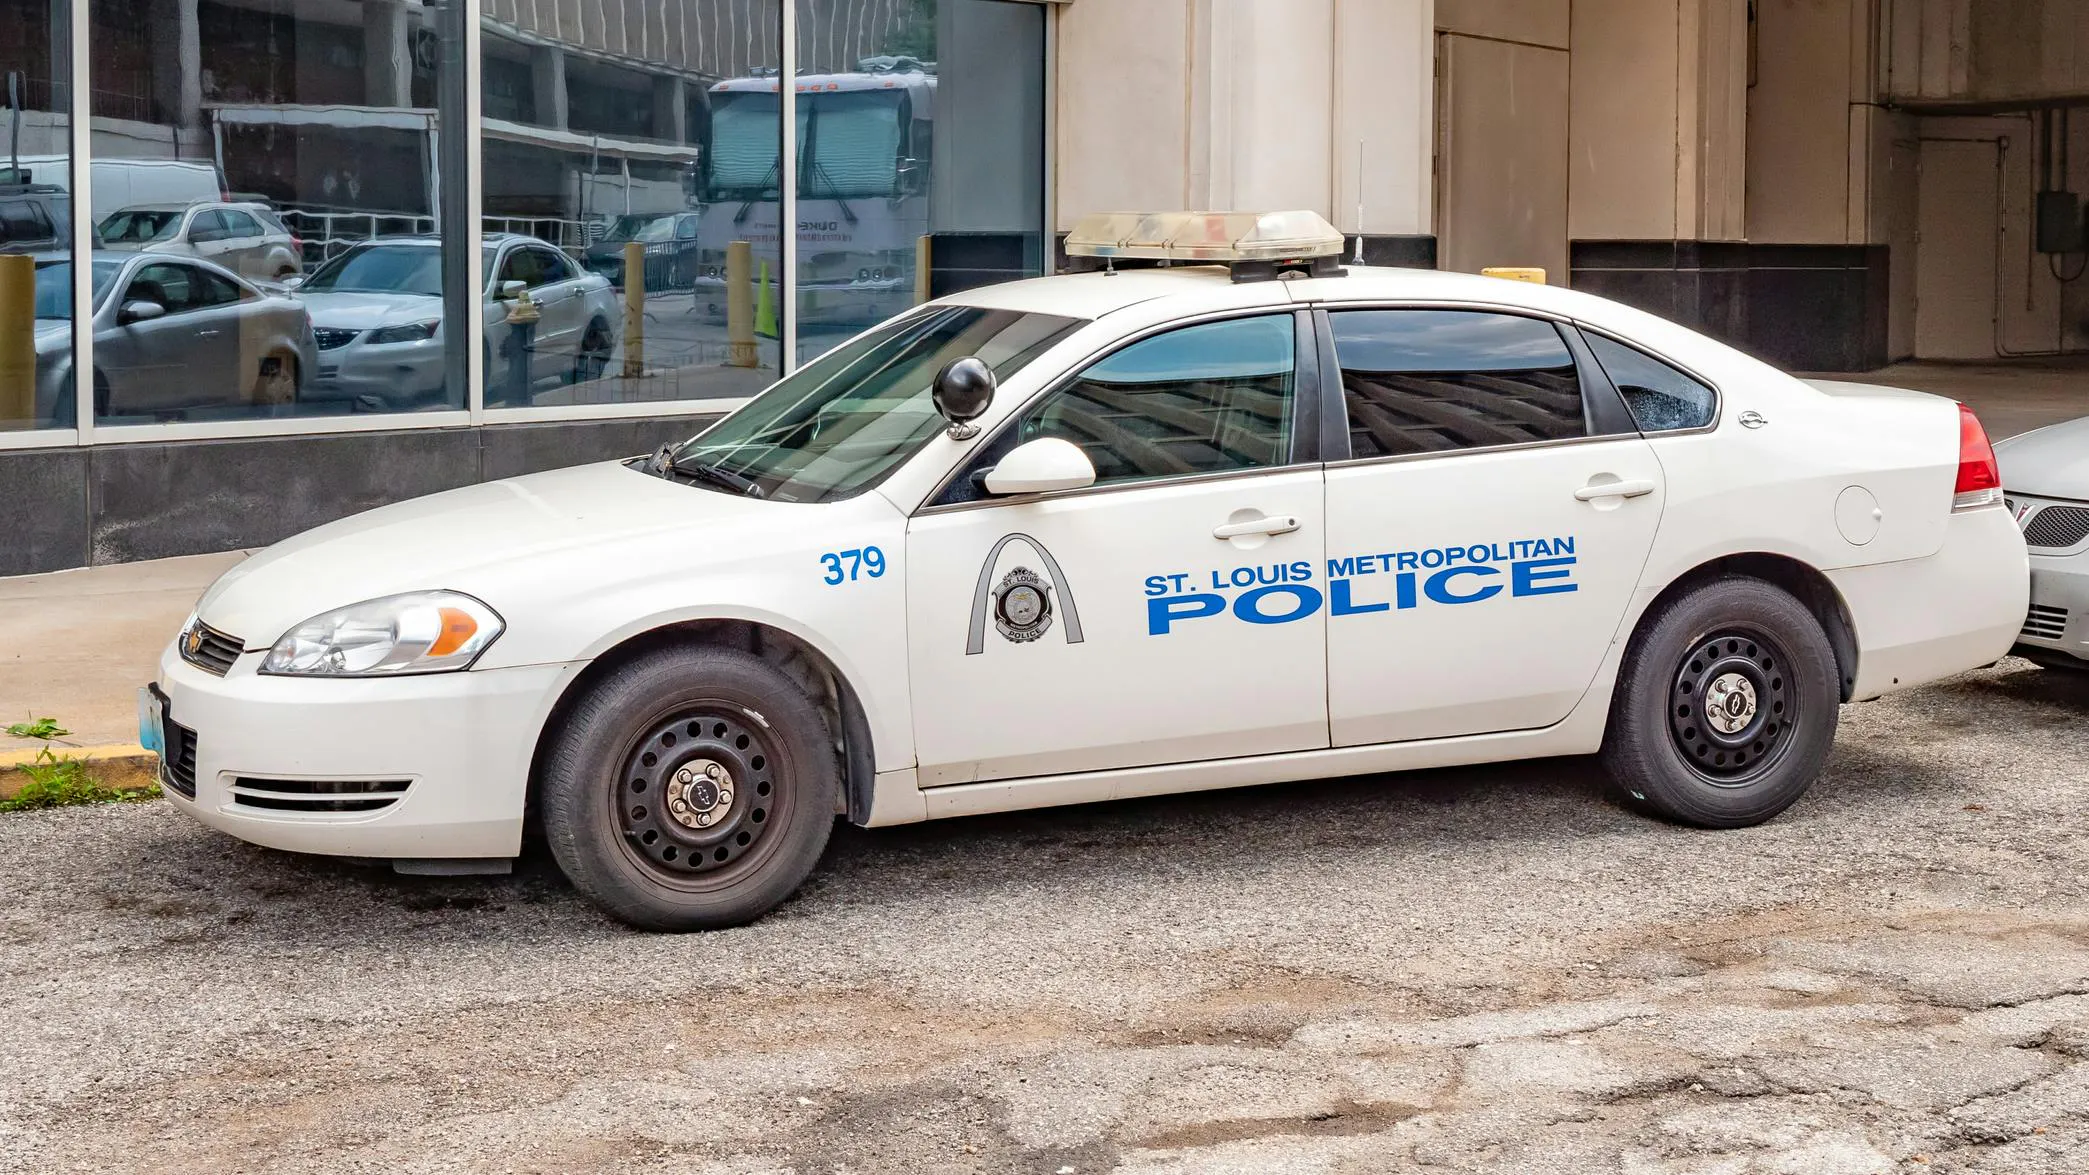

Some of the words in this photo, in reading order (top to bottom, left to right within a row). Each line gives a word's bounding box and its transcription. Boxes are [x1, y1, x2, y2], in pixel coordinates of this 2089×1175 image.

[820, 545, 886, 586] 379
[1016, 576, 1039, 585] LOUIS
[1144, 573, 1196, 596] ST.
[1212, 561, 1313, 590] LOUIS
[1327, 536, 1575, 578] METROPOLITAN
[1147, 556, 1579, 636] POLICE
[1008, 629, 1041, 639] POLICE
